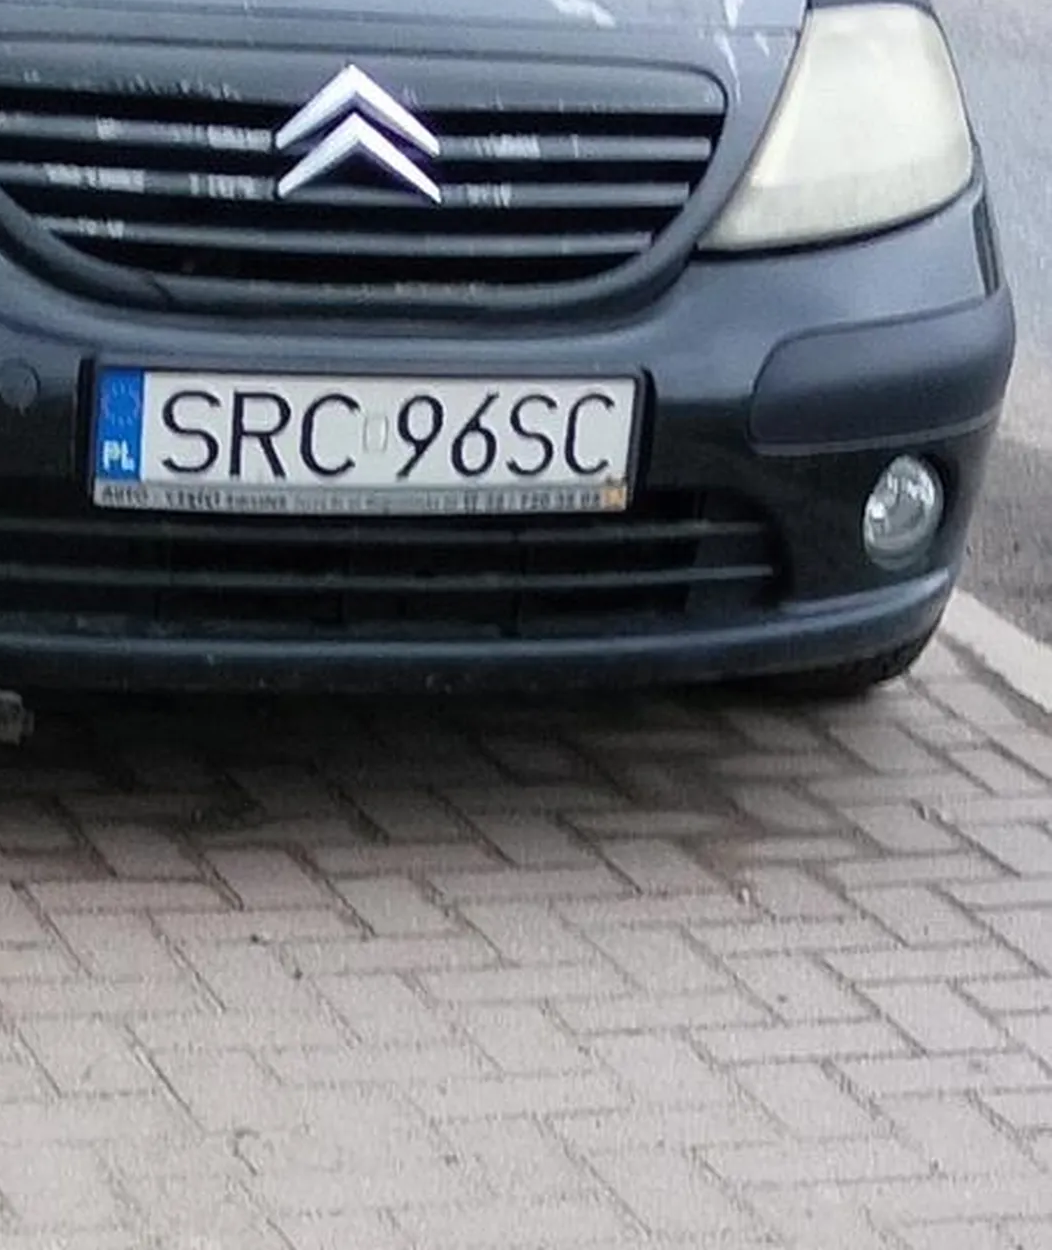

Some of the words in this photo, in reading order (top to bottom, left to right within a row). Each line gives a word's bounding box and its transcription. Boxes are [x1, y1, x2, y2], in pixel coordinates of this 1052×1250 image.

[102, 439, 135, 472] PL
[161, 389, 361, 480] SRC
[395, 392, 616, 480] 96SC
